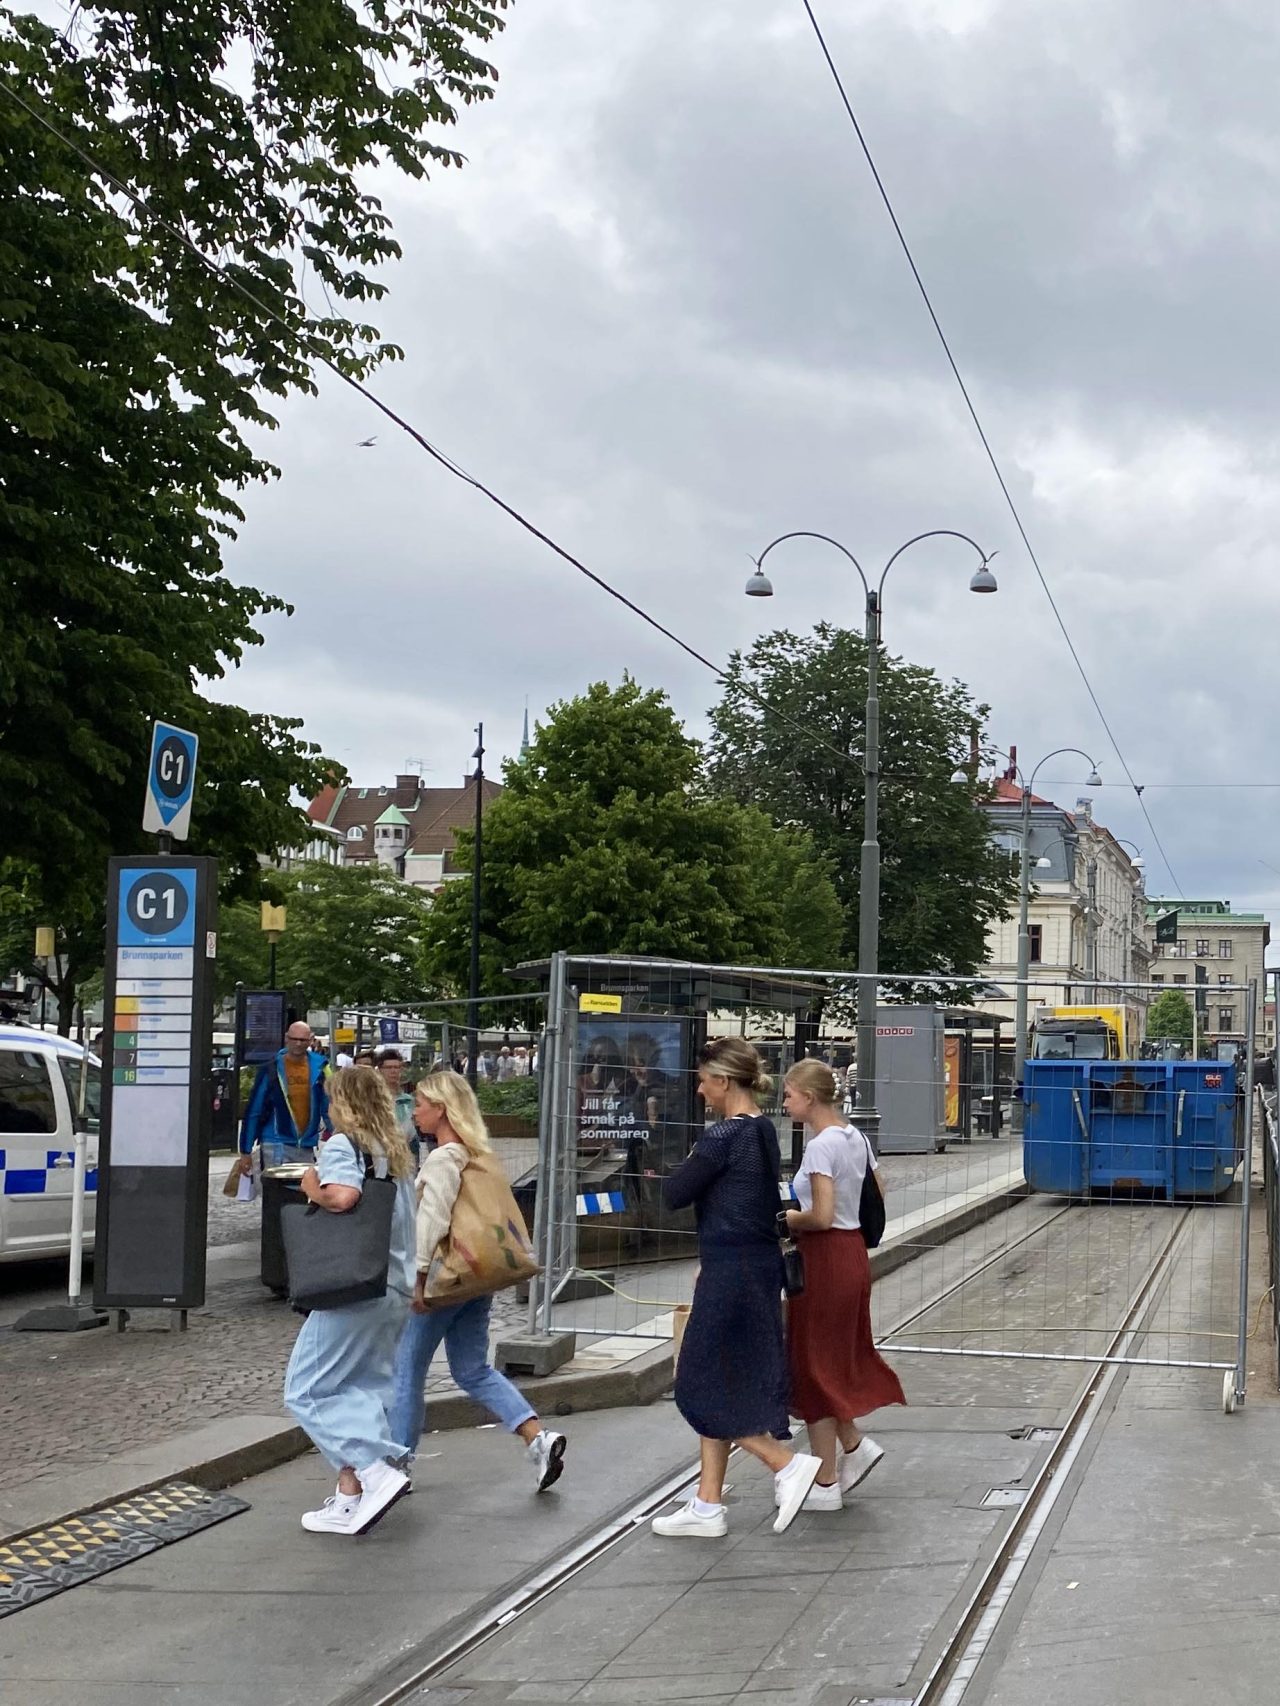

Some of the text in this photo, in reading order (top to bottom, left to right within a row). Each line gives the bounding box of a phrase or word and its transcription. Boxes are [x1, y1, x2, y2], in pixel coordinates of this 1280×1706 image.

[161, 750, 184, 785] C1
[136, 888, 175, 920] C1
[121, 950, 183, 963] Brunnsparken
[600, 984, 649, 993] Brunnsparken
[128, 1036, 135, 1047] 4
[129, 1053, 135, 1064] 7
[124, 1070, 135, 1083] 16
[581, 1097, 621, 1111] Jill får
[580, 1112, 635, 1127] smak på
[580, 1129, 649, 1140] sommaren
